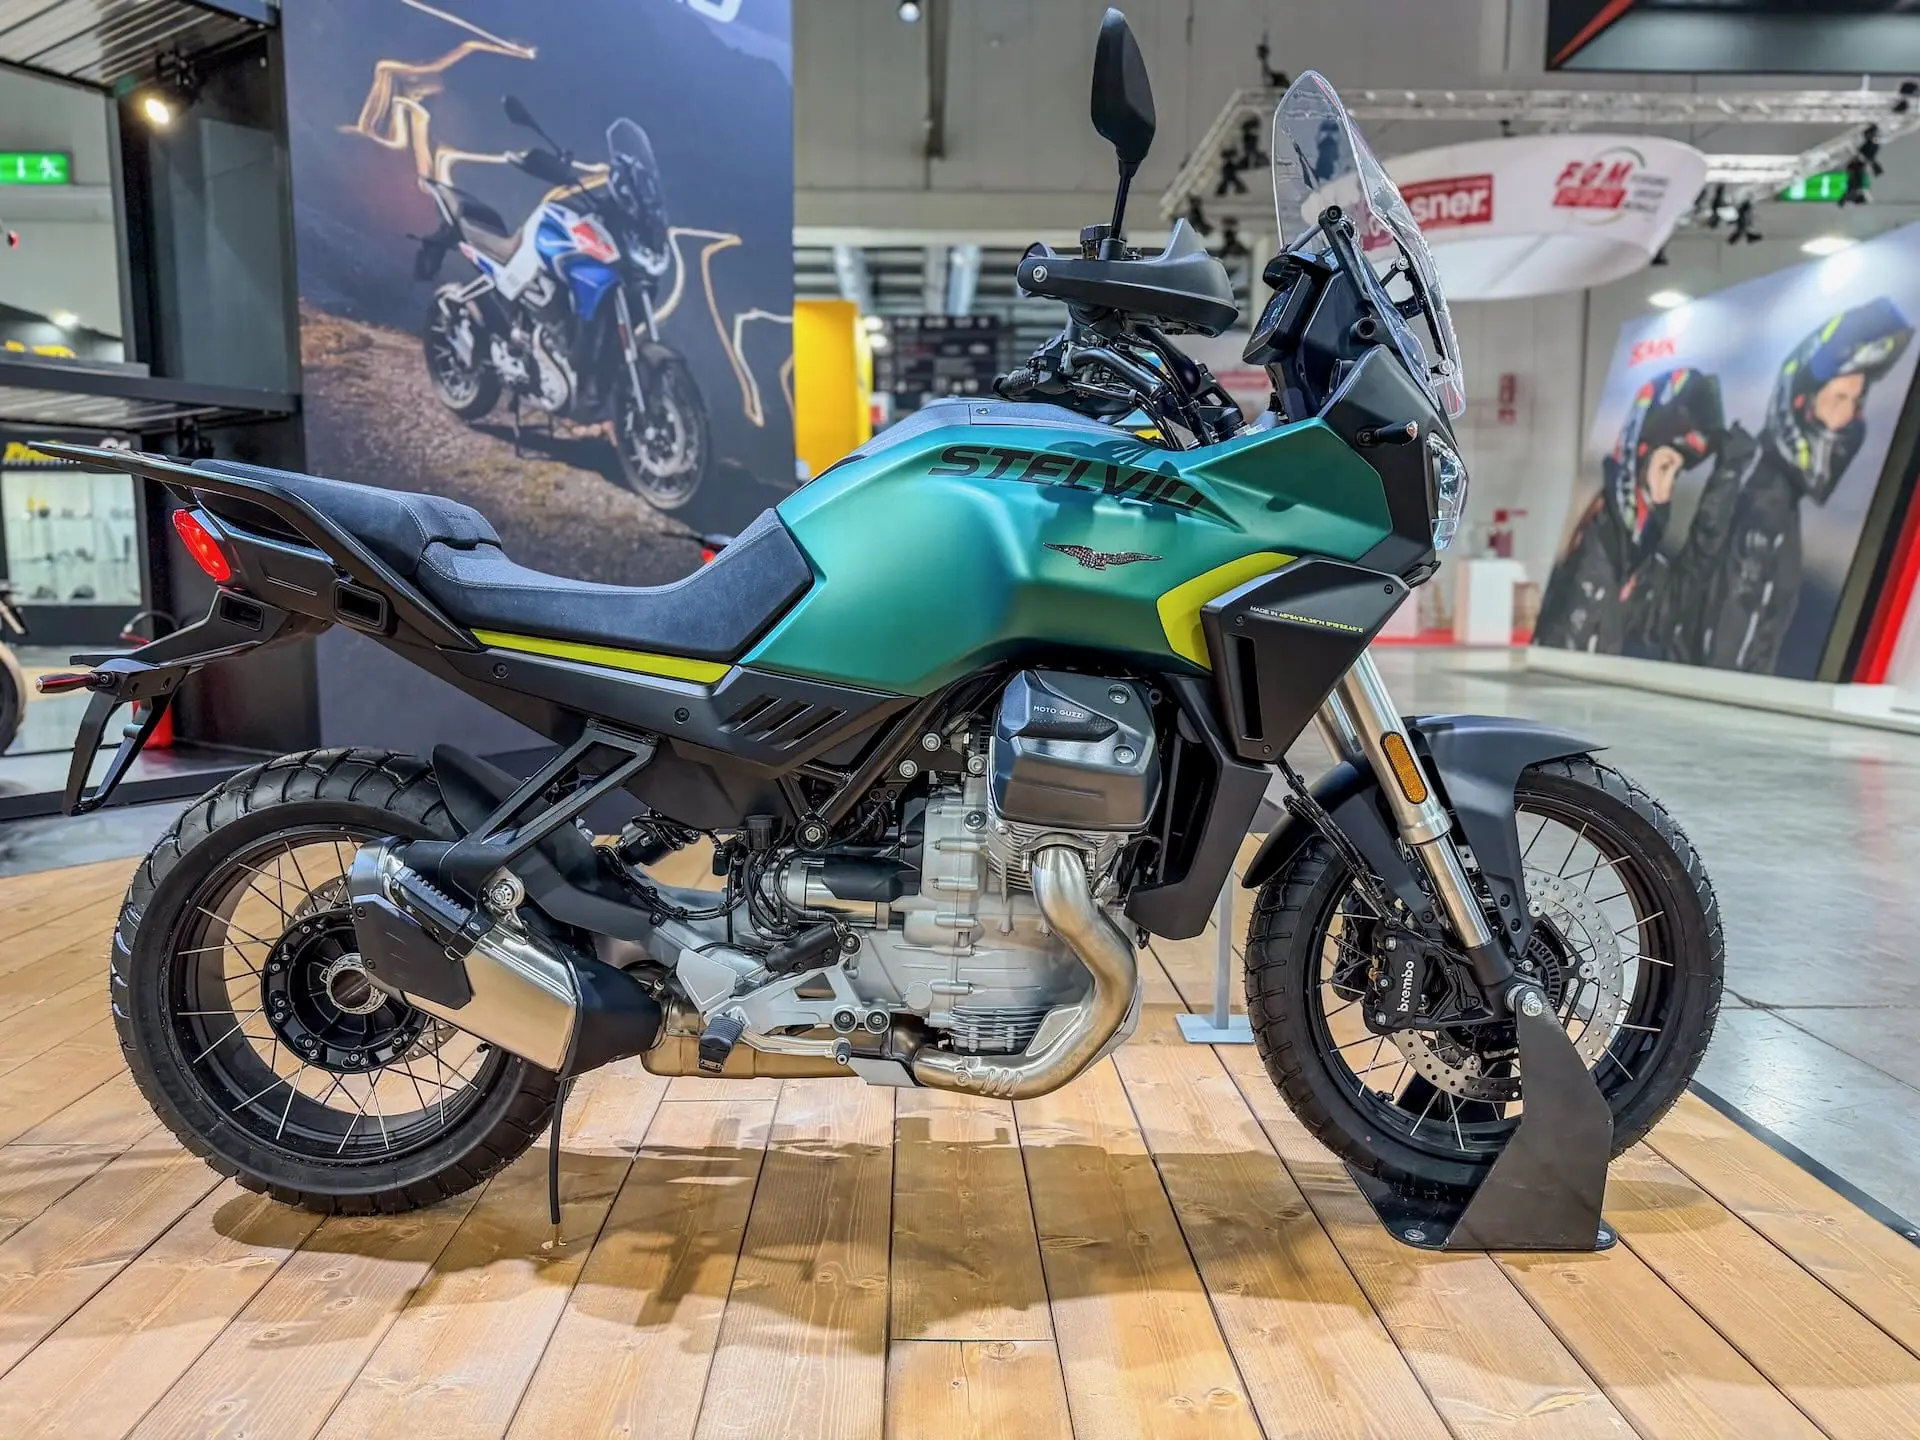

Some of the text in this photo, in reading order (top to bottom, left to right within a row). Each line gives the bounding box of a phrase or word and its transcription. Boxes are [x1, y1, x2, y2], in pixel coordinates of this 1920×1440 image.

[928, 445, 1206, 511] STELVIO
[1249, 606, 1269, 615] MADE
[1033, 705, 1084, 719] MOTO GUZZI
[1396, 960, 1415, 1012] brembo
